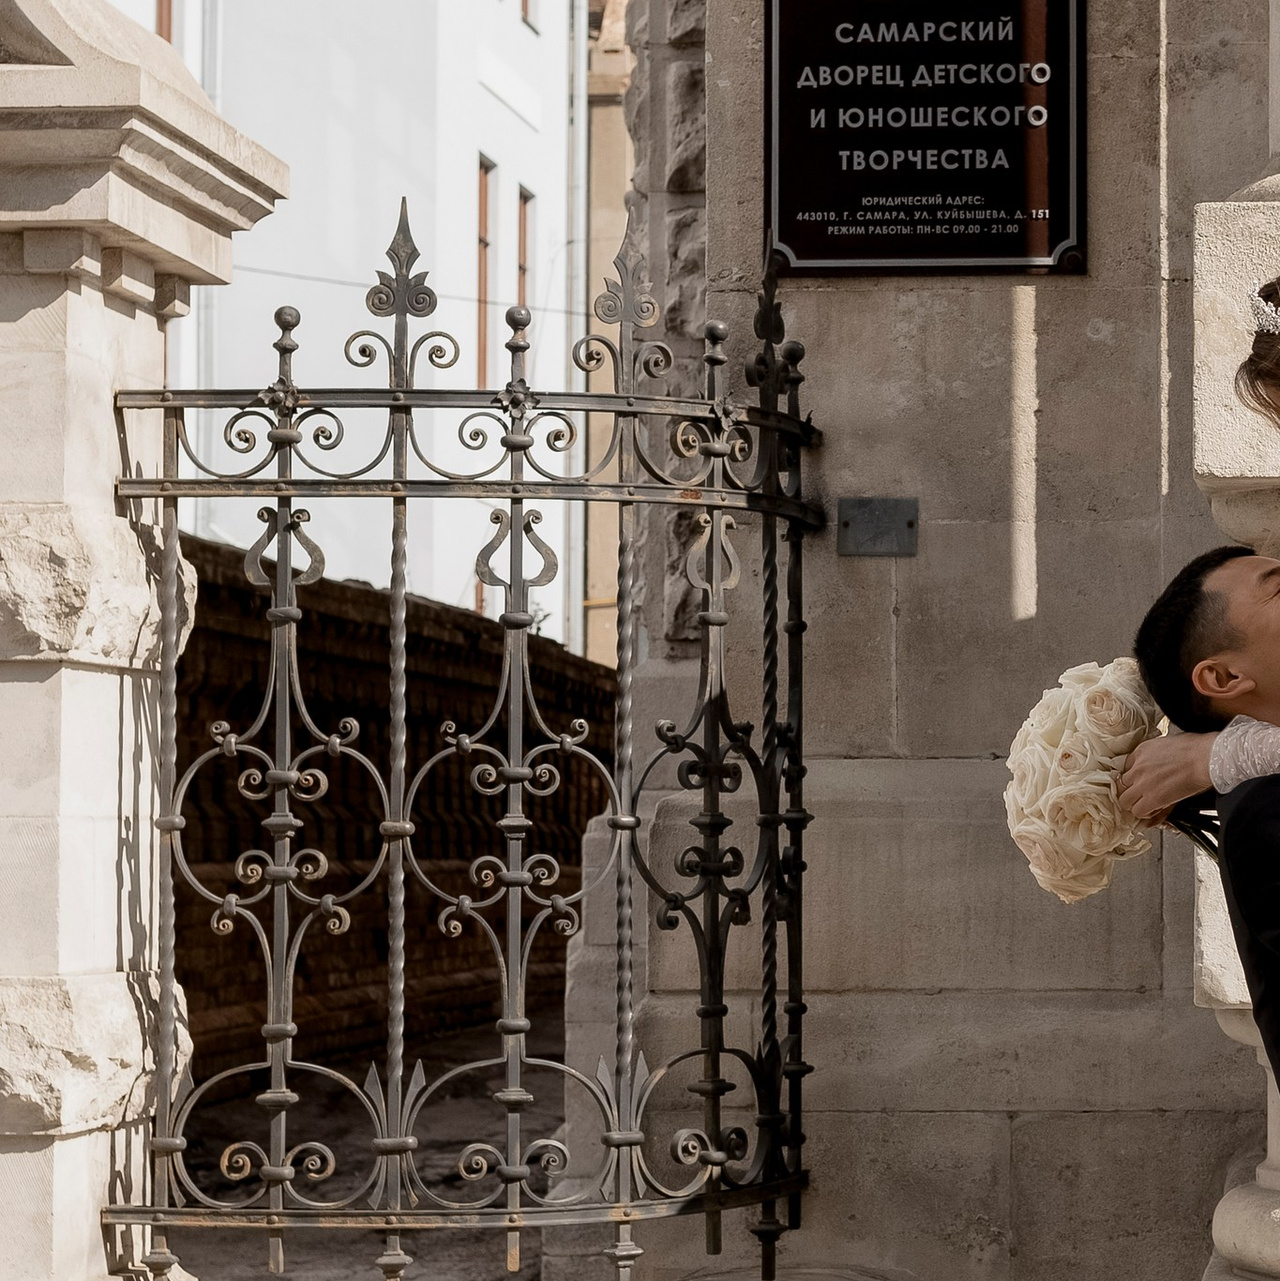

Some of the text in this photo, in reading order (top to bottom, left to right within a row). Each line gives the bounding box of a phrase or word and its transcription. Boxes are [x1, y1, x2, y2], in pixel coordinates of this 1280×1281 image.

[835, 16, 1013, 43] САМАРСКИЙ
[796, 63, 1052, 88] ДВОРЕЦ ДЕТСКОГО
[810, 105, 1048, 128] И ЮНОШЕСКОГО
[838, 149, 1010, 170] ТВОРЧЕСТВА
[862, 194, 985, 205] ЮРИДИЧЕСКИЙ АДРЕС:
[796, 212, 839, 220] 443010,
[843, 212, 853, 221] Г.
[856, 212, 910, 220] САМАРА,
[914, 212, 932, 220] УЛ.
[1014, 211, 1027, 219] Д.
[1031, 209, 1050, 218] 151
[868, 226, 914, 234] РАБОТЫ:
[916, 225, 950, 233] ПН-ВС
[952, 225, 981, 233] 09.00
[991, 225, 1019, 233] 21.00
